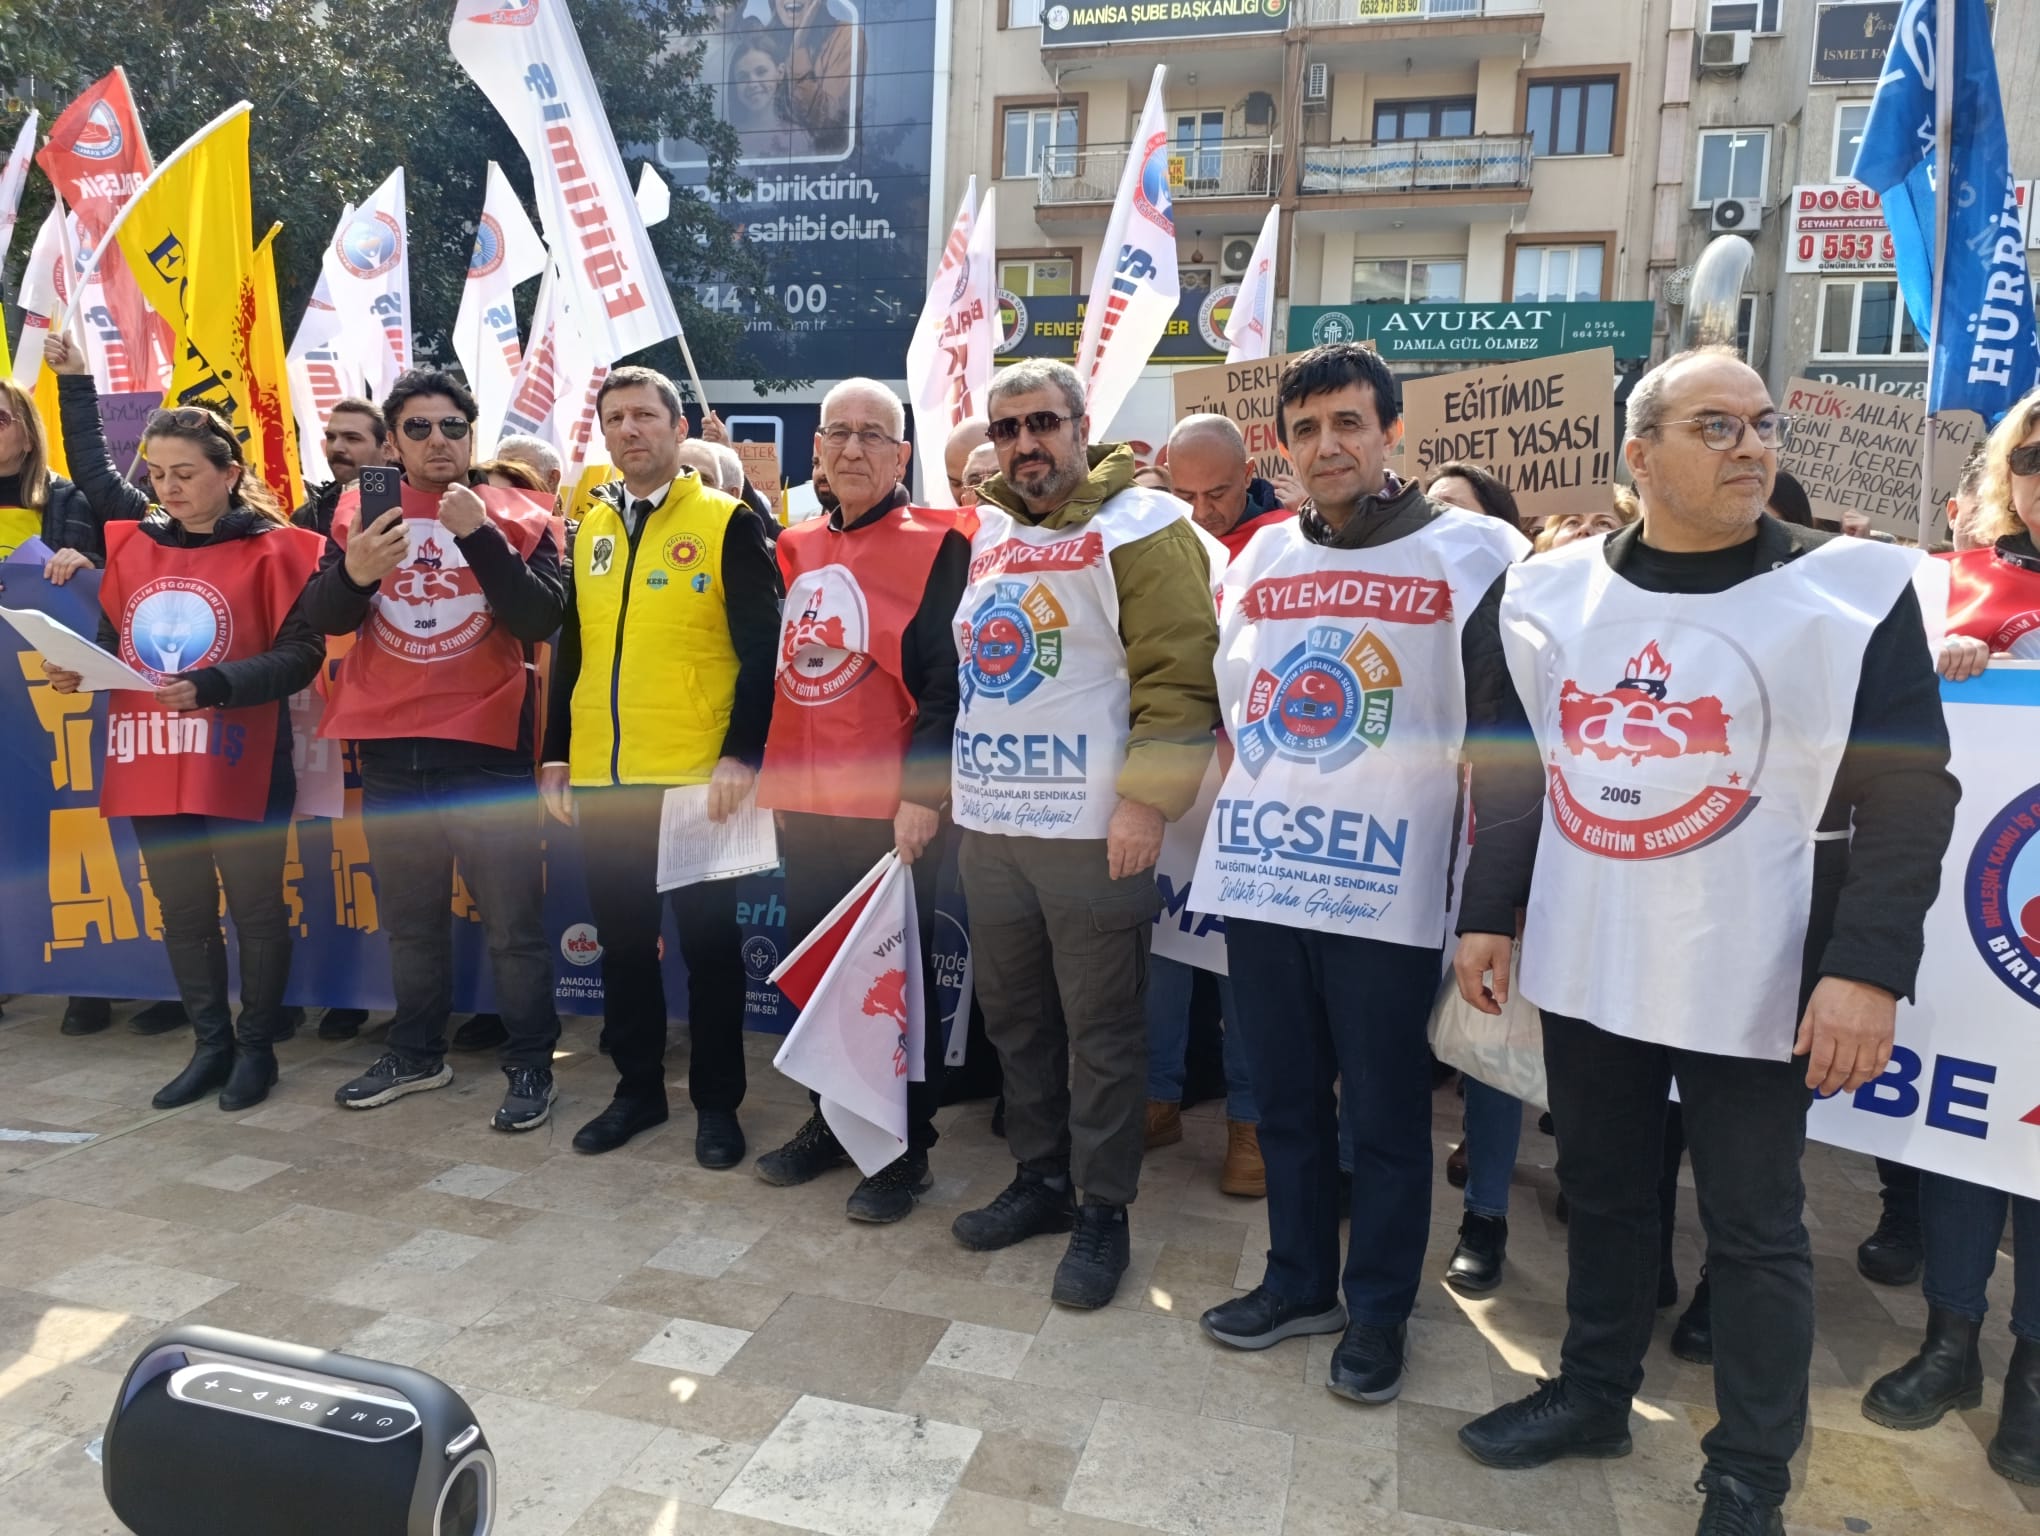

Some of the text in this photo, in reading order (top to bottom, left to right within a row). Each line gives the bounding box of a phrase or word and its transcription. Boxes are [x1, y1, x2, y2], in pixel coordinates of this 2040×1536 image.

[1073, 5, 1127, 25] MANİSA
[1131, 4, 1167, 25] ŞUBE
[1823, 48, 1888, 61] İSMET FA
[758, 172, 879, 204] biriktirin,
[749, 213, 827, 242] sahibi
[830, 214, 896, 241] olun.
[1801, 218, 1888, 230] SEYAHAT ACENTE
[1798, 234, 1815, 261] 0
[1822, 234, 1875, 261] 553
[1866, 262, 1877, 270] VE
[1381, 311, 1552, 331] AVUKAT
[1584, 321, 1615, 329] 0 545
[1394, 336, 1539, 350] DAMLA GÜL ÖLMEZ
[1227, 362, 1284, 393] DERH
[1236, 396, 1275, 421] OKU
[1444, 373, 1564, 424] EĞİTİMDE
[1788, 390, 1852, 419] RTÜK:
[1417, 414, 1600, 472] ŞİDDET YASASI
[1839, 425, 1918, 457] BIRAKIN
[1256, 579, 1440, 616] EYLEMDEYİZ
[440, 614, 488, 652] SENDİKASI
[1311, 630, 1343, 650] 4/B
[1039, 636, 1059, 668] THS
[1355, 643, 1390, 684] YHS
[1250, 680, 1272, 716] SHS
[1364, 697, 1390, 737] THS
[1578, 697, 1694, 754] aes
[106, 711, 209, 764] Eğitim
[211, 713, 246, 767] iş
[1282, 730, 1298, 748] TEÇ
[1307, 736, 1328, 749] SEN
[955, 727, 1087, 786] TEÇ-SEN
[1600, 785, 1642, 805] 2005
[1551, 771, 1732, 852] ANADOLU EĞİTİM SENDİKASI
[1216, 798, 1409, 868] TEÇ-SEN
[1987, 824, 2021, 868] KAMU
[1257, 864, 1331, 886] ÇALIŞANLARI
[1256, 882, 1301, 908] Daha
[1304, 888, 1393, 924] Güçlüyüz!
[1978, 865, 2004, 929] BİRLEŞİK
[556, 987, 605, 999] EĞİTİM-SEN
[560, 976, 602, 987] ANADOLU
[745, 1004, 778, 1016] İTİM-SEN
[746, 991, 780, 1004] RRİYETÇİ
